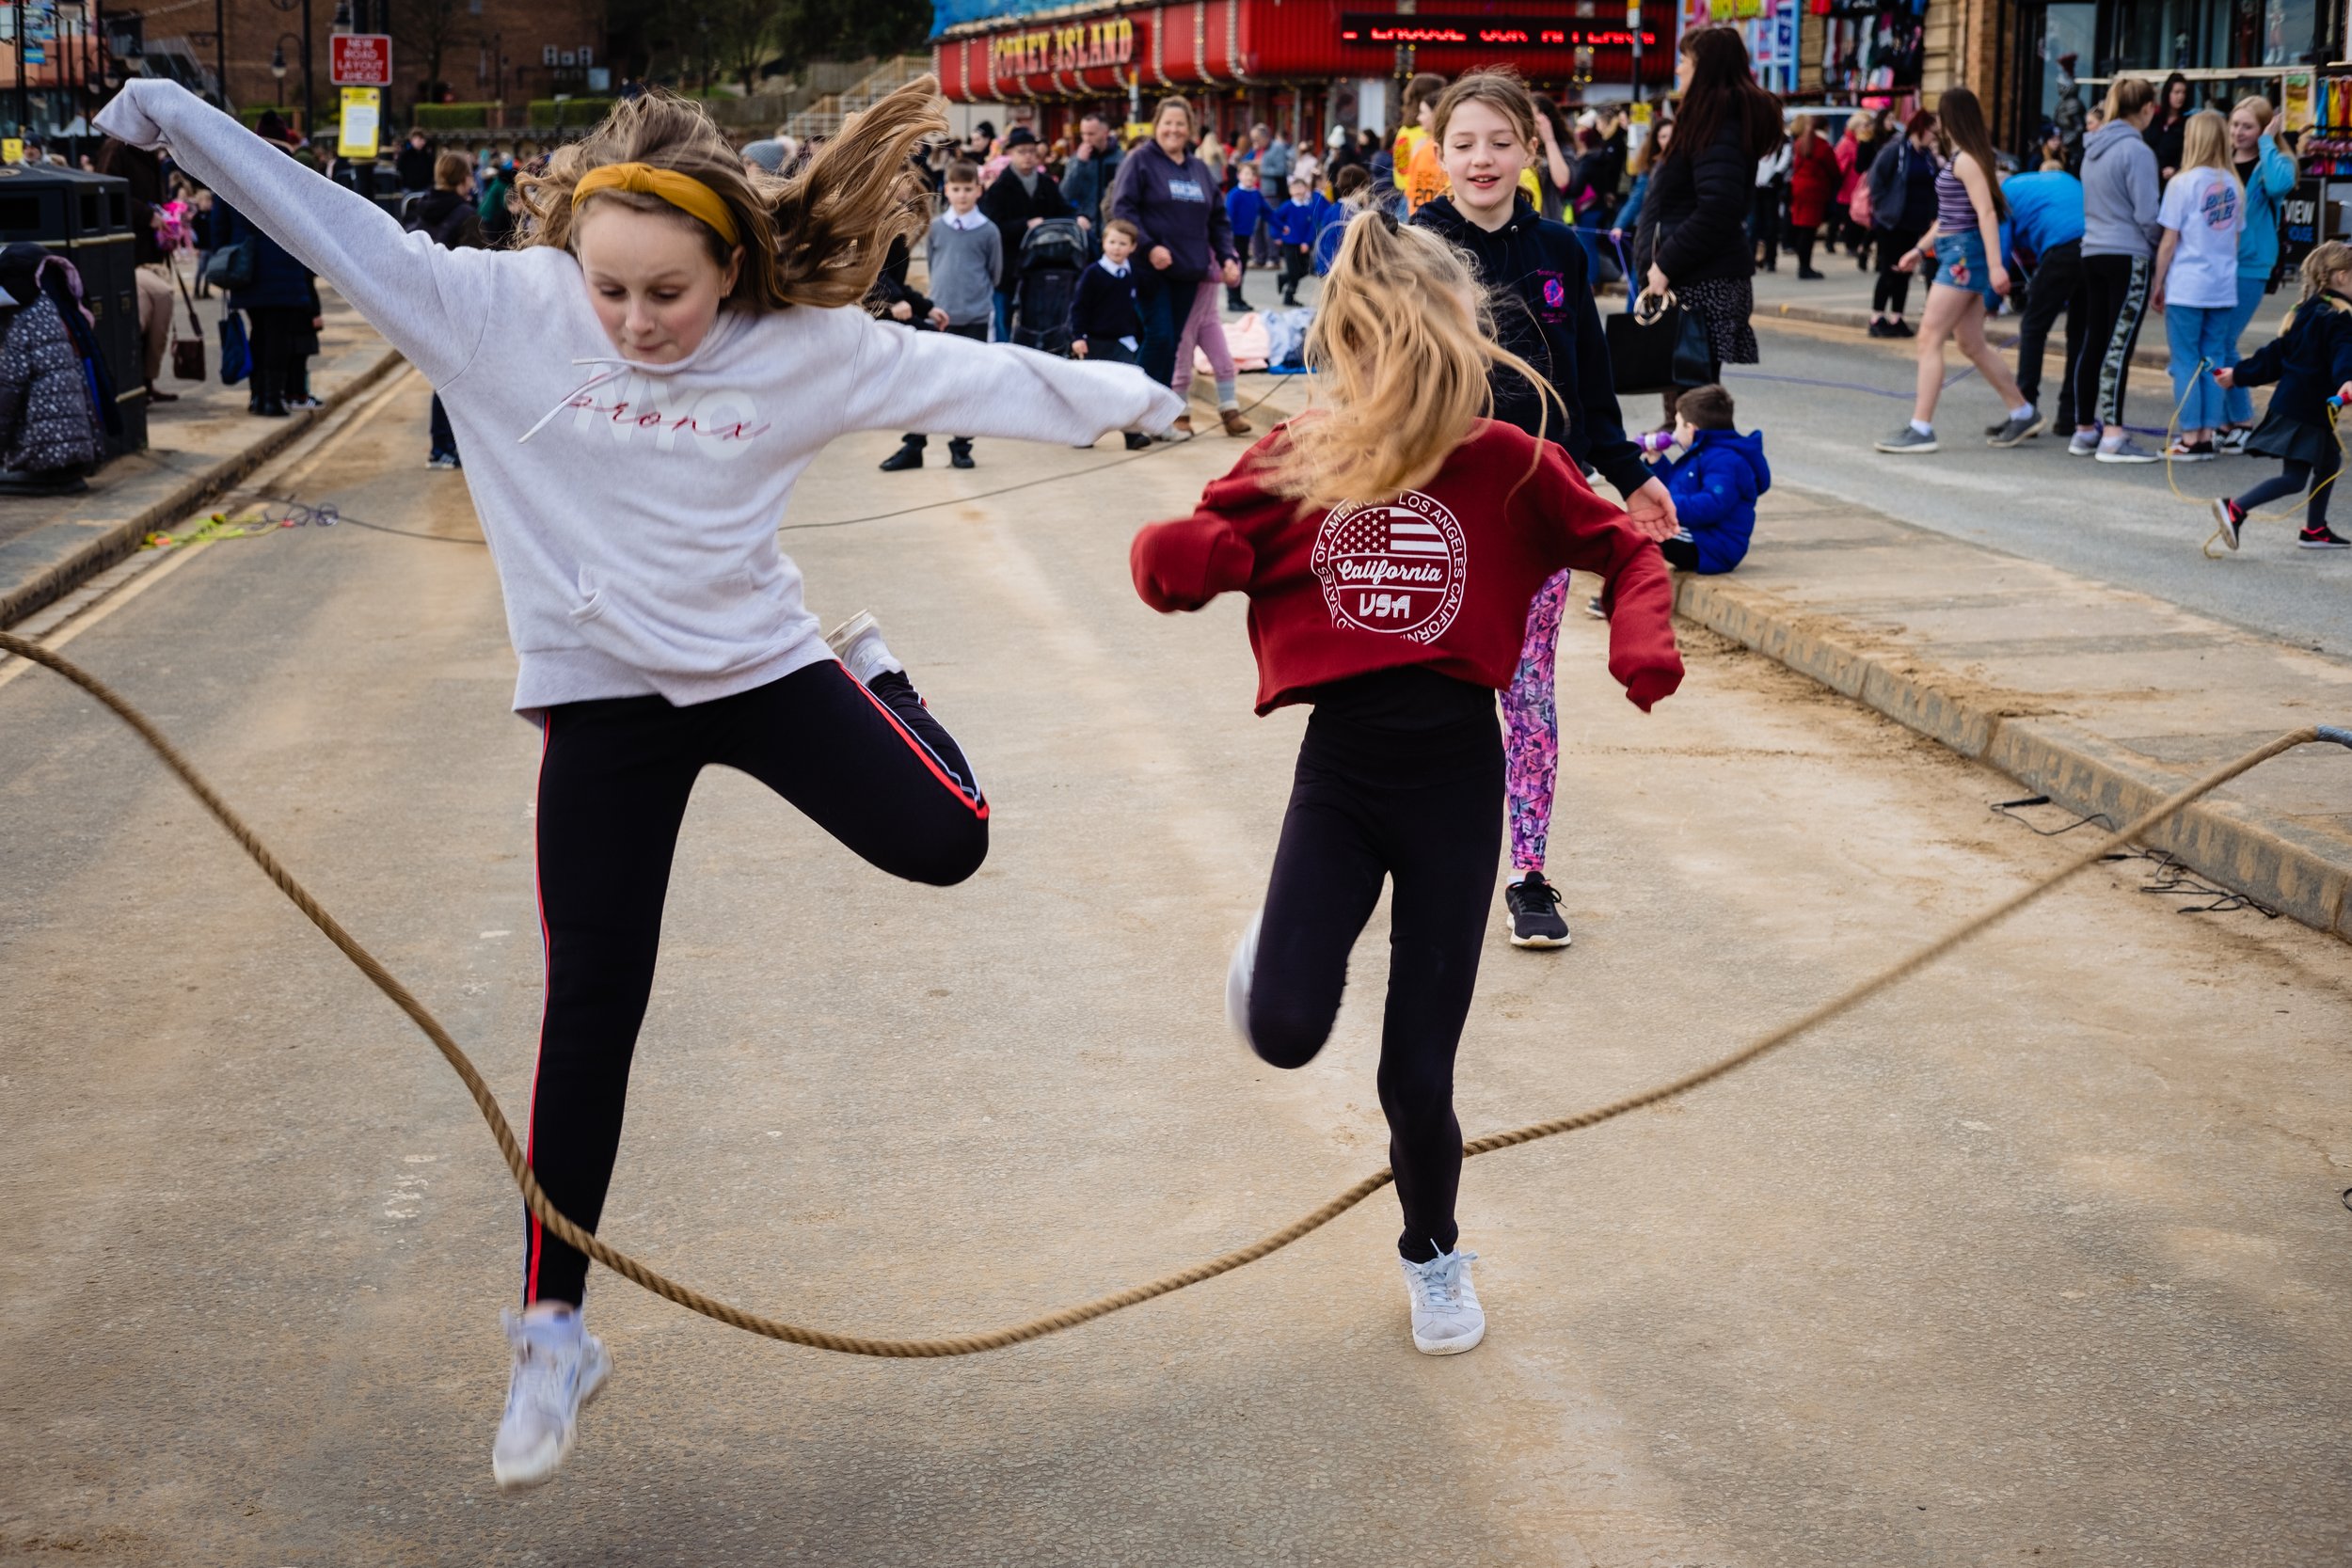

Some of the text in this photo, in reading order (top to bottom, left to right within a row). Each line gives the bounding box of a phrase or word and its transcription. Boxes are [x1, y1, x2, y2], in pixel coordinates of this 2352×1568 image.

[343, 48, 378, 60] ROAD
[346, 39, 375, 47] NEW
[995, 17, 1133, 77] CONEY ISLAND
[337, 59, 384, 71] LAYOUT
[342, 71, 381, 82] AHEAD
[1315, 540, 1327, 562] OF
[1336, 559, 1443, 585] California
[1398, 492, 1464, 643] LOS ANGELES CALIFORN
[1359, 593, 1411, 620] USA
